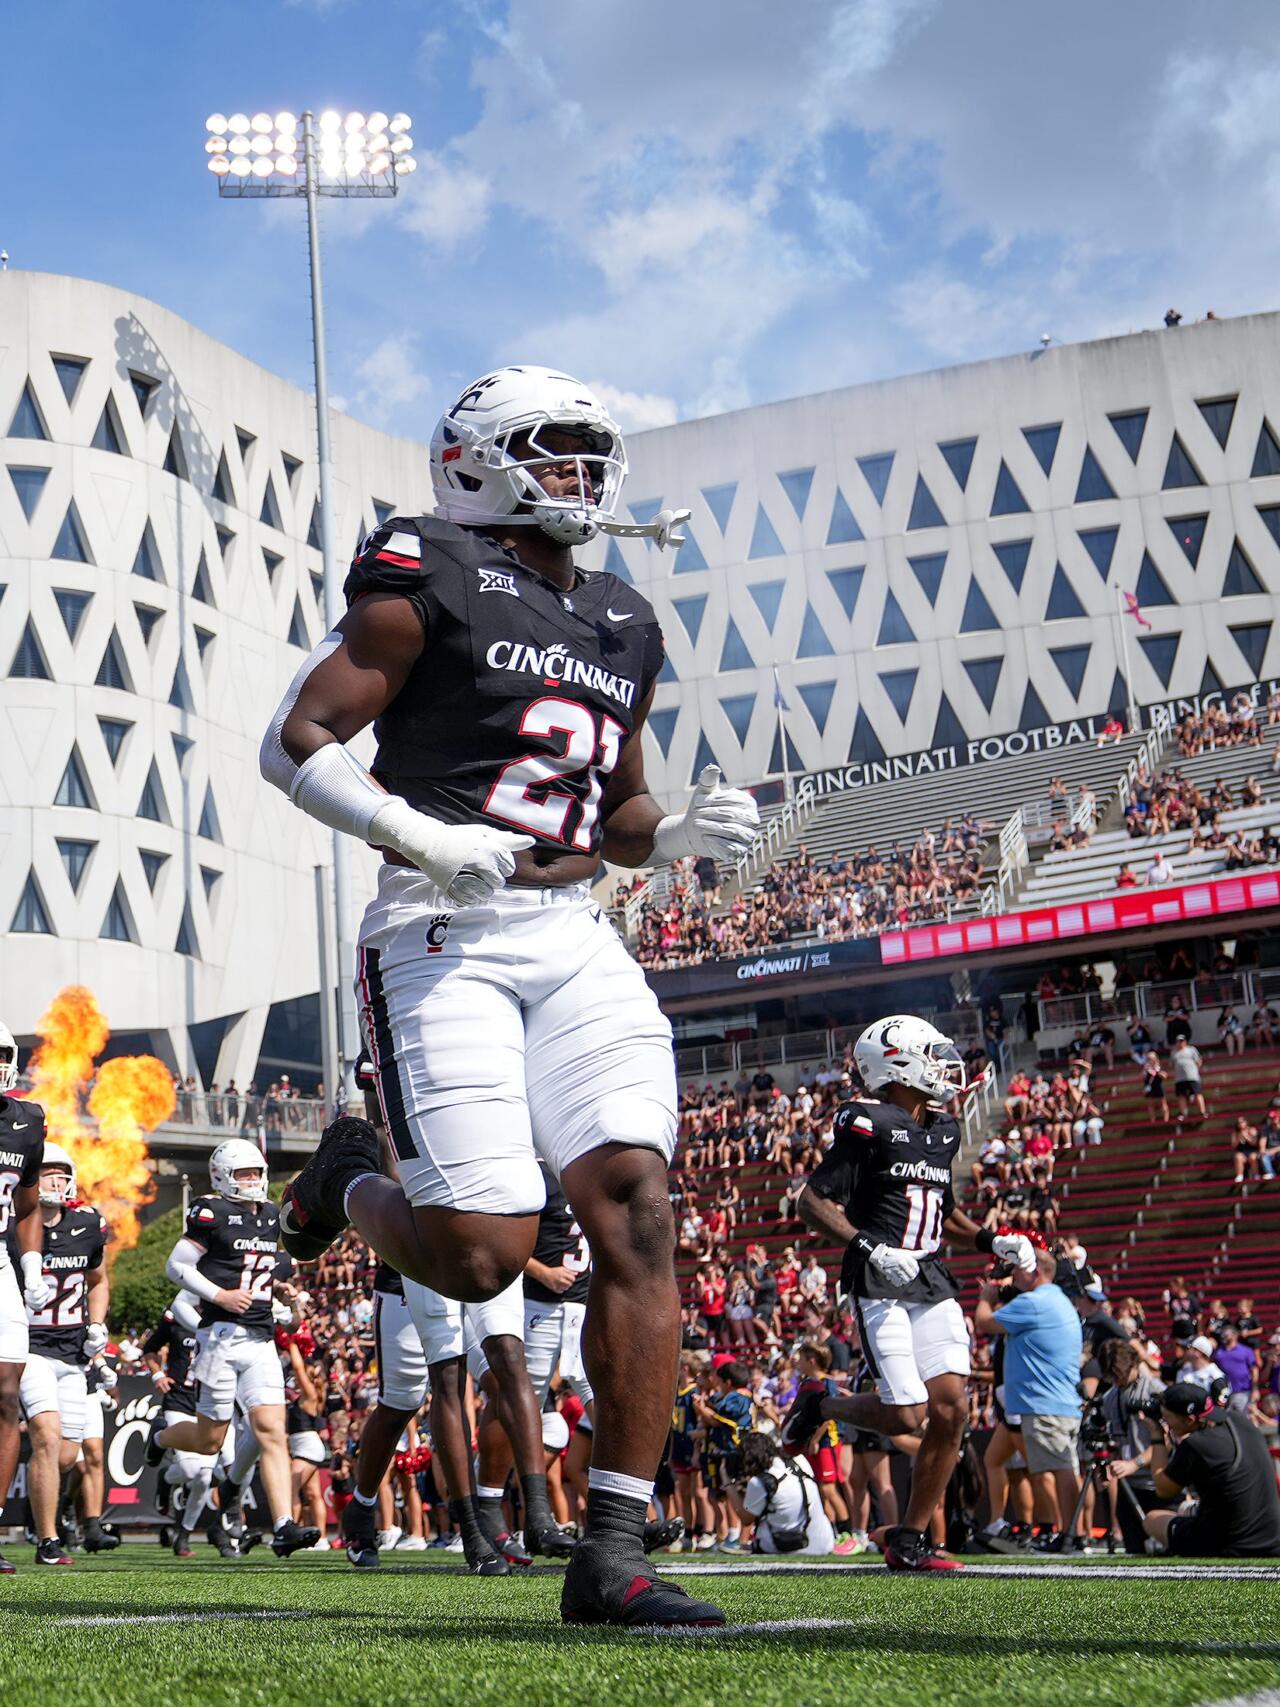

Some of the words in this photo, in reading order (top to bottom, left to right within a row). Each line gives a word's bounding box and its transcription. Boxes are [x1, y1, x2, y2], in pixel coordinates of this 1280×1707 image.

[486, 640, 636, 709] CINCINNATI
[482, 695, 629, 852] 21
[799, 745, 957, 796] CINCINNATI
[966, 719, 1100, 765] FOOTBAL
[737, 957, 801, 979] CINCINNATI
[880, 1020, 904, 1047] C
[901, 1184, 944, 1253] 10
[42, 1254, 88, 1269] CINNATI
[564, 1221, 593, 1273] 3
[240, 1253, 276, 1302] 12
